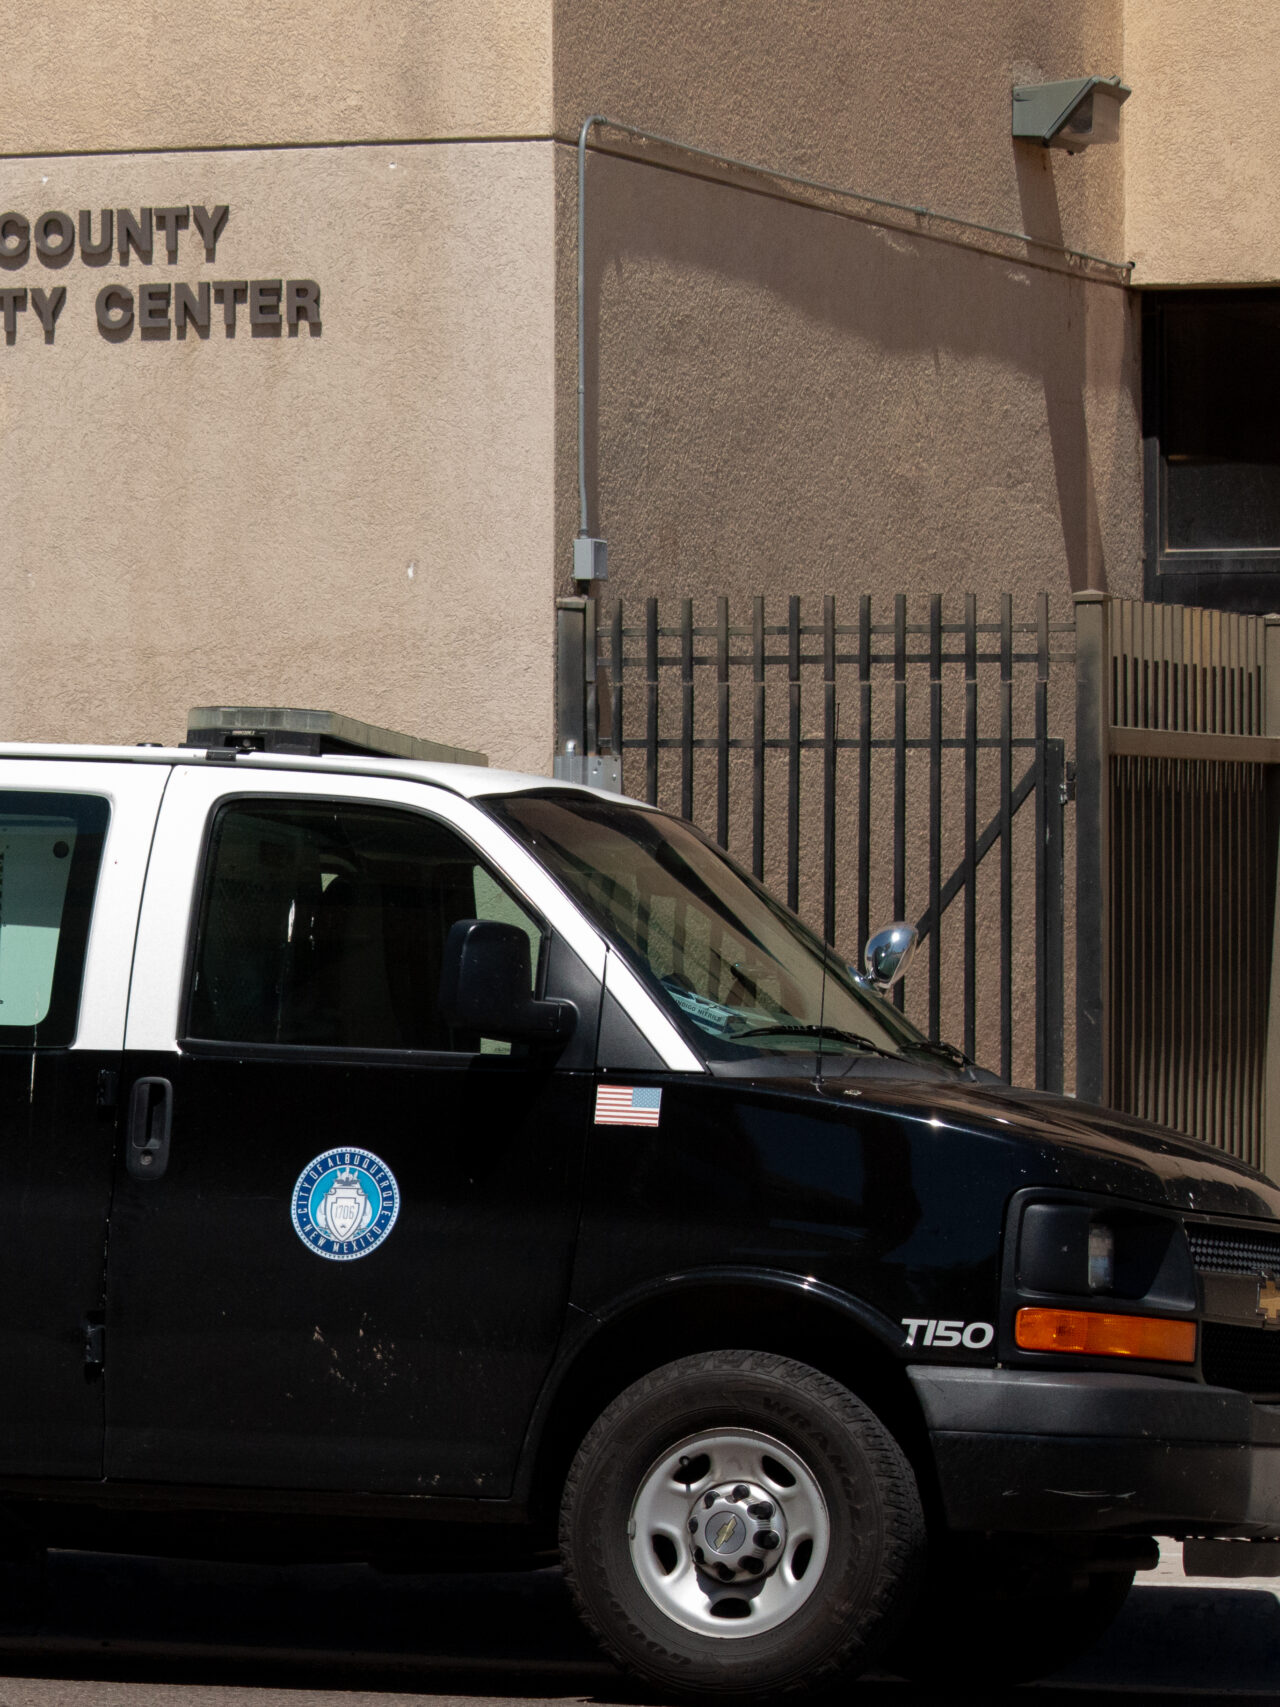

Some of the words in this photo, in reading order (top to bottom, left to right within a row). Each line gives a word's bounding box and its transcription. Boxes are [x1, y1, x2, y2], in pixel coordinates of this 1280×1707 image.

[96, 279, 322, 330] CENTER
[297, 1182, 311, 1214] CITY
[309, 1164, 324, 1179] OF
[327, 1154, 393, 1217] ALBUQUERQUE
[335, 1205, 355, 1220] 1706
[303, 1224, 327, 1247] NEW
[332, 1227, 382, 1253] MEXICO
